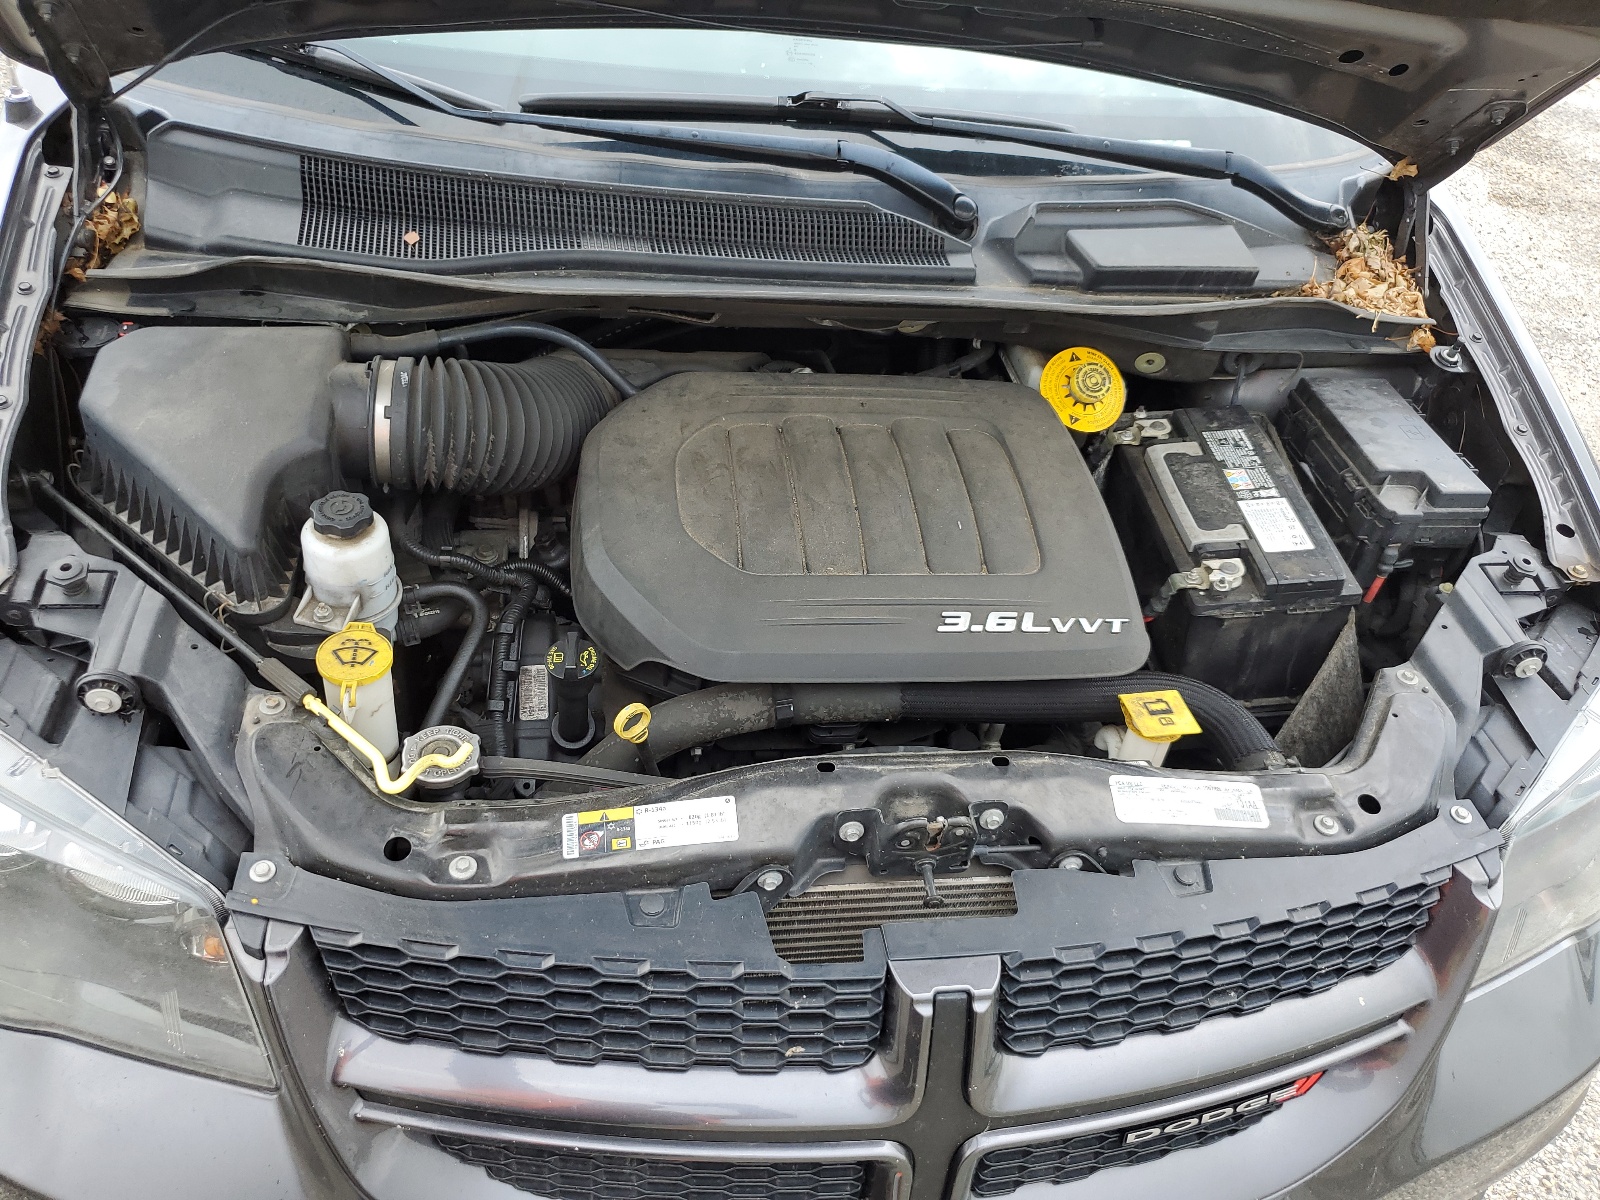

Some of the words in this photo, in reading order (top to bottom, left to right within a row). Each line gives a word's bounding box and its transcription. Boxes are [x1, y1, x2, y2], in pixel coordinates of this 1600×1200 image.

[936, 611, 1051, 634] 3.6L
[1051, 617, 1130, 634] VVT
[585, 663, 595, 671] OIL
[415, 728, 440, 742] KEEP
[445, 728, 469, 741] TIGHT
[1124, 1083, 1299, 1145] DODGE
